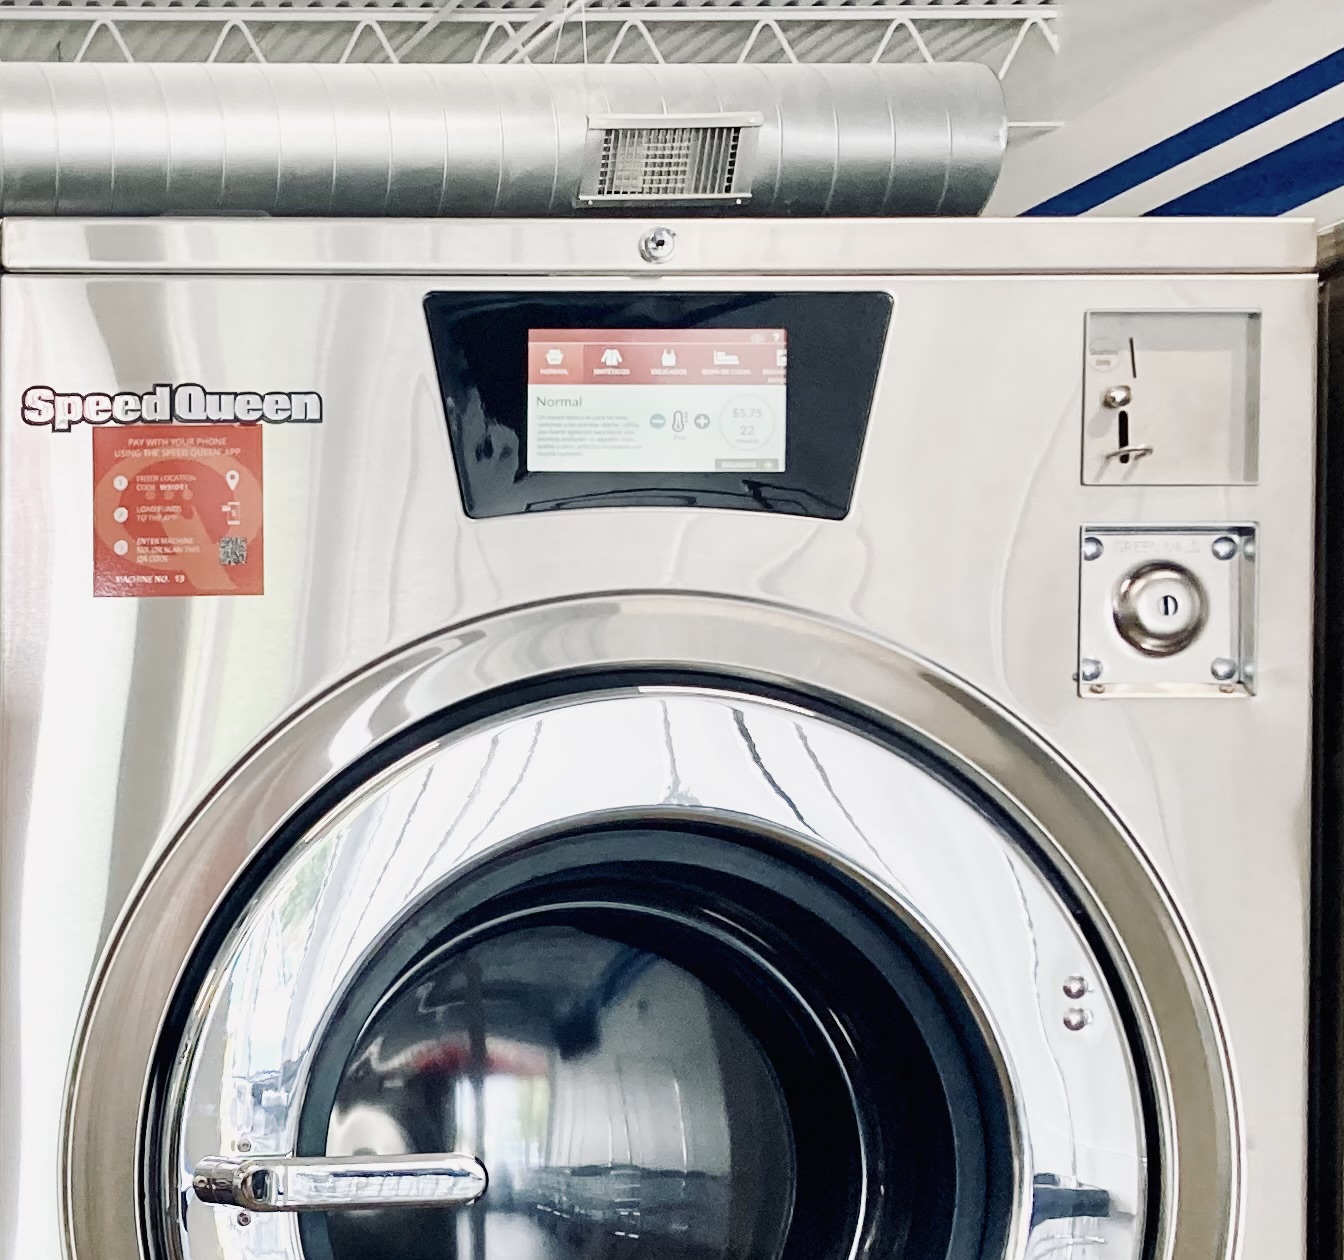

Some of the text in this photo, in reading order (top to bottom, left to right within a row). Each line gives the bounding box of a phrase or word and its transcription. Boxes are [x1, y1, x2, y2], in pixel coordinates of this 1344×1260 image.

[536, 395, 582, 407] Normal
[732, 407, 762, 419] $5.75
[740, 425, 754, 436] 22
[128, 437, 227, 446] PAY WITH YOUR PHONE
[114, 449, 141, 458] USING
[143, 449, 160, 457] THE
[222, 448, 241, 456] APP
[154, 575, 170, 583] NO.
